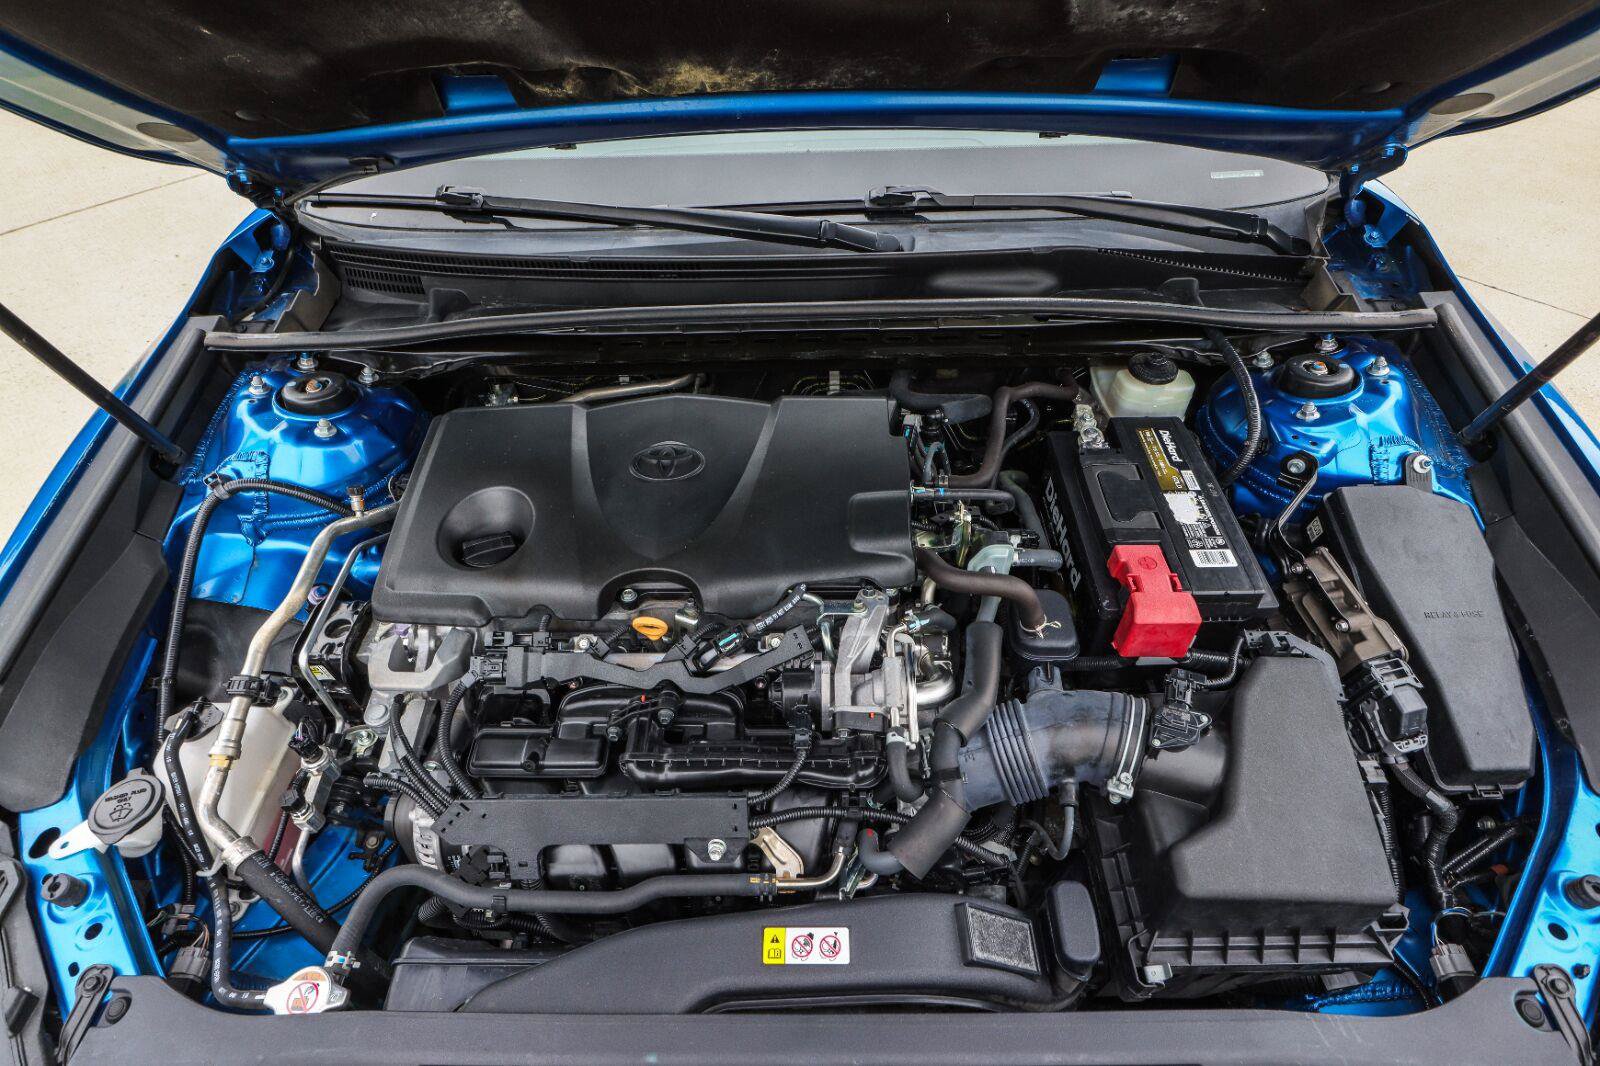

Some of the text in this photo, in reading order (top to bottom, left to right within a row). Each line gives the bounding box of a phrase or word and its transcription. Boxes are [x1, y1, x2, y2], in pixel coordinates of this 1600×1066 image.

[1159, 430, 1183, 462] DieHard
[1045, 476, 1082, 592] DieHard
[1423, 611, 1452, 619] RELAY
[1461, 610, 1485, 618] FUSE
